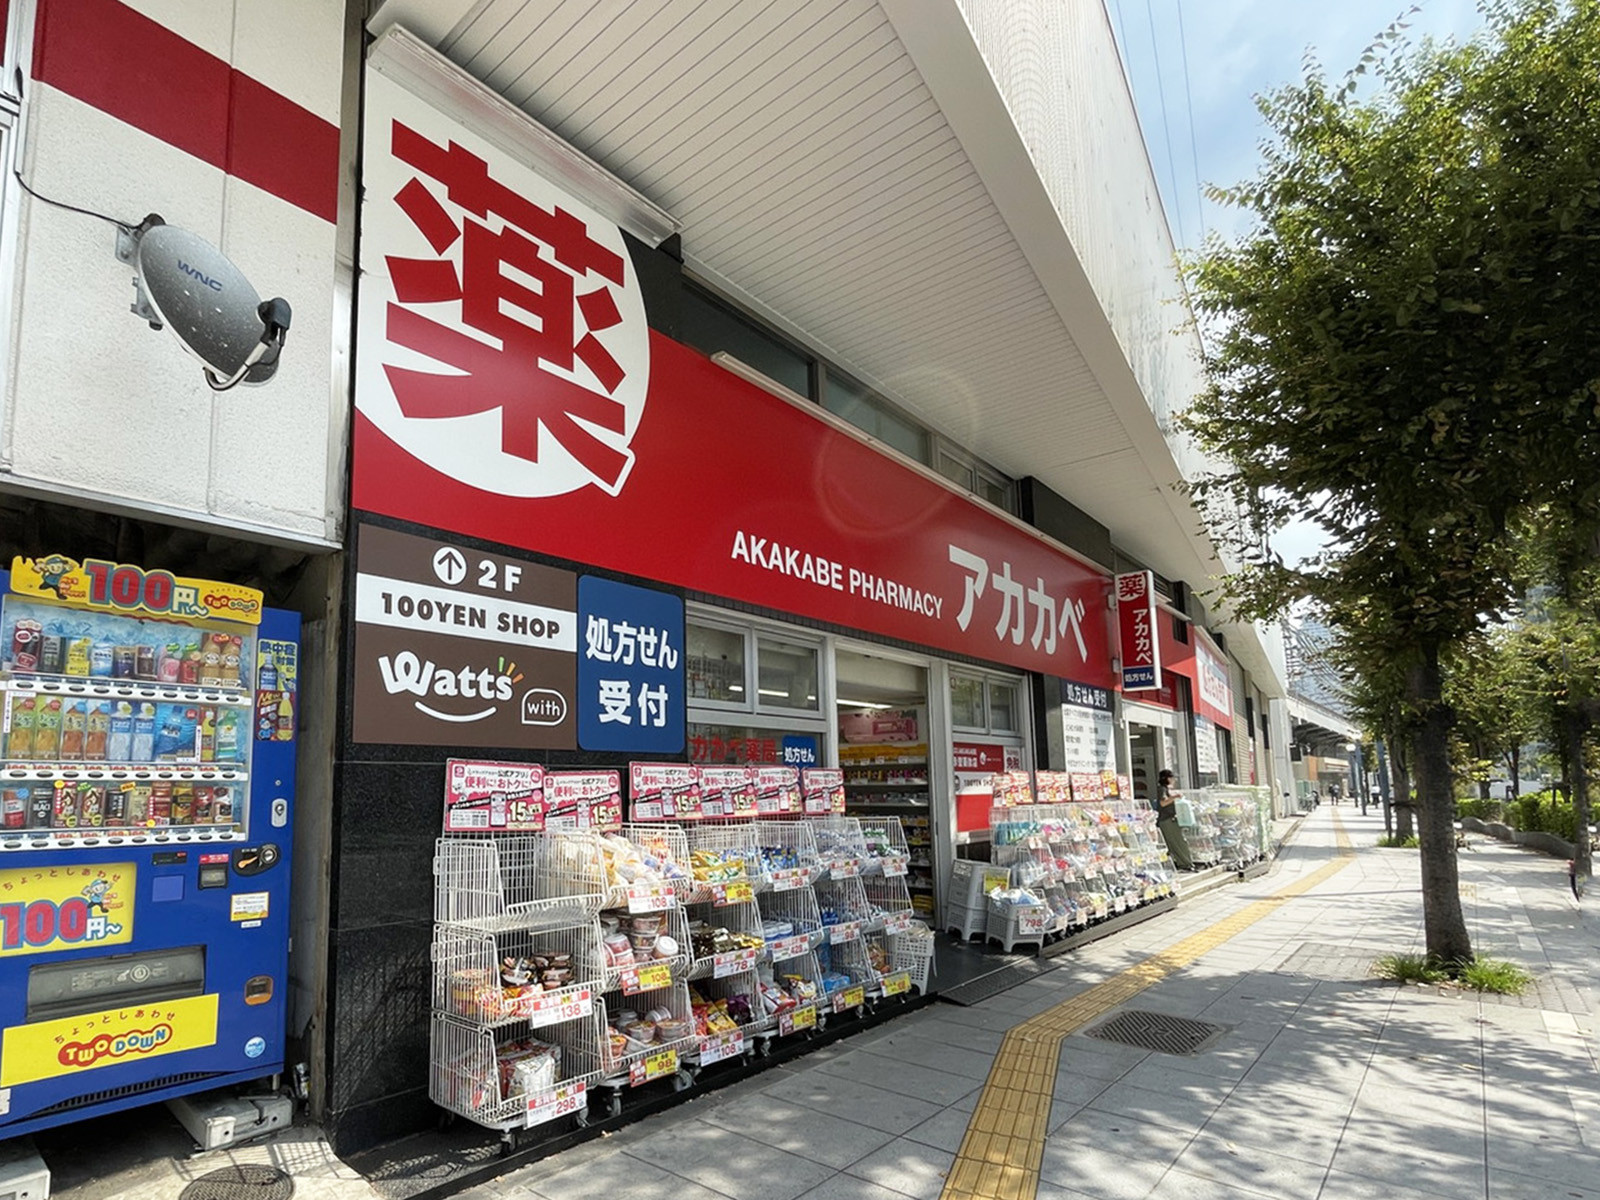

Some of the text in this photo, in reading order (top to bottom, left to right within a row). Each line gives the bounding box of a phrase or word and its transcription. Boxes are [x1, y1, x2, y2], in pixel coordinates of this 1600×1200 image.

[177, 259, 223, 292] WNC
[382, 118, 626, 488] 薬
[478, 559, 522, 592] 2F
[731, 530, 943, 620] AKAKABE PHARMACY
[1118, 573, 1145, 599] 薬
[381, 592, 561, 640] 100YEN SHOP
[948, 543, 1087, 664] アカカベ
[585, 614, 678, 671] 処方せん
[1132, 607, 1153, 665] アカカベ
[377, 650, 514, 701] Watts
[1124, 672, 1154, 683] 処方せん
[527, 702, 561, 718] with
[599, 679, 669, 728] 受付
[784, 746, 815, 764] 処方せん
[3, 867, 121, 891] ちょっとしあわせ
[651, 897, 667, 909] 108
[1025, 918, 1043, 928] 798
[651, 972, 668, 982] 108
[734, 960, 748, 972] 78
[561, 1003, 581, 1018] 138
[54, 1009, 176, 1045] ちょっとしあわせ
[66, 1028, 167, 1063] TWO DOWN
[721, 1043, 736, 1056] 108
[657, 1058, 673, 1070] 98
[556, 1097, 577, 1115] 298
